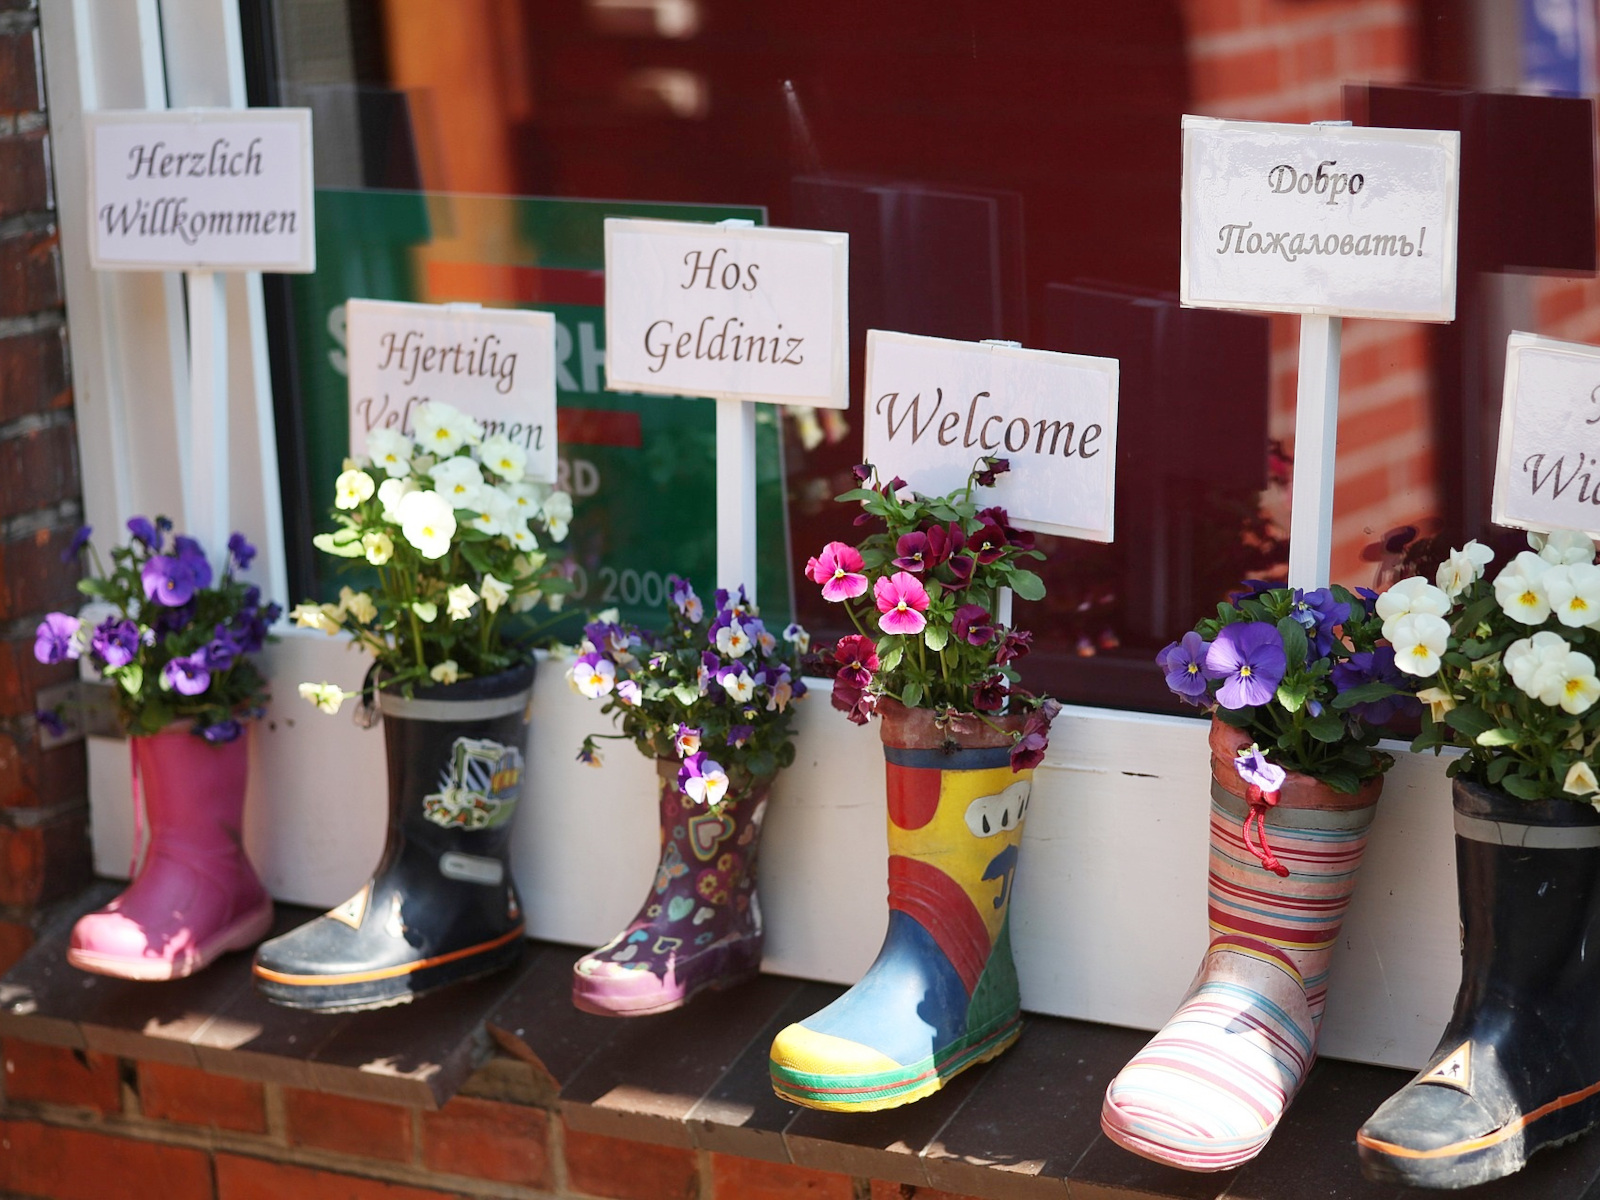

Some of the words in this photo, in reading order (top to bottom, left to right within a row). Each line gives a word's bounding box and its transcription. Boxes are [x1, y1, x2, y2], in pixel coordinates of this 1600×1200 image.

[126, 137, 263, 180] Herzlich
[1268, 160, 1365, 205] Добро
[99, 197, 298, 245] Willkommen
[1216, 221, 1426, 263] Пожаловать!
[681, 248, 760, 291] Hos
[378, 330, 517, 394] Hjertilig
[644, 316, 804, 373] Geldiniz
[357, 394, 545, 451] Velmen
[876, 387, 1102, 459] Welcome
